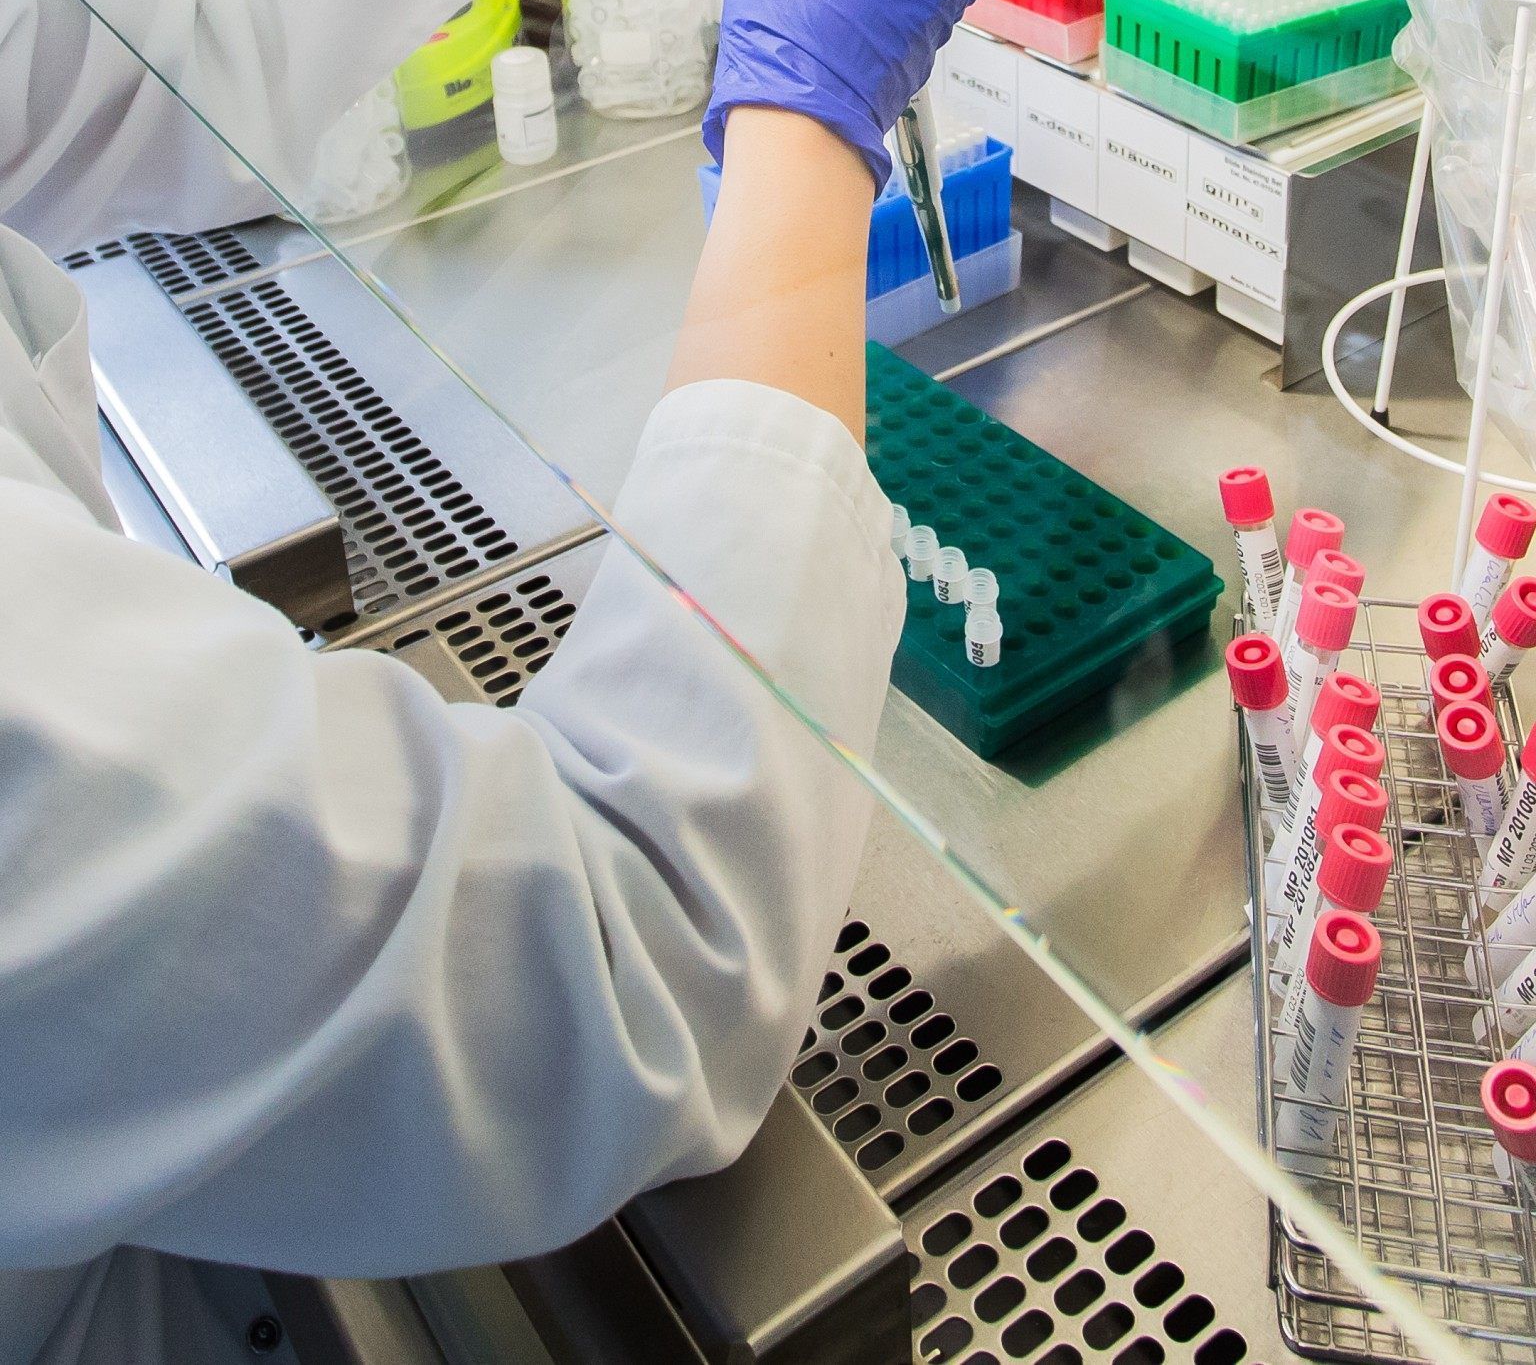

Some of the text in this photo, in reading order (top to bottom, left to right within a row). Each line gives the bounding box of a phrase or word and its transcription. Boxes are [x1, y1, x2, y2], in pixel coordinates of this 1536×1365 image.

[1029, 110, 1090, 147] a.dest.
[1107, 139, 1174, 179] bläuen
[1205, 183, 1259, 218] gill's
[1186, 200, 1279, 258] hematox
[1496, 836, 1515, 868] MP
[1508, 781, 1536, 841] 201080
[1283, 870, 1299, 901] MP
[1282, 914, 1296, 950] MP
[1516, 976, 1536, 1005] MP
